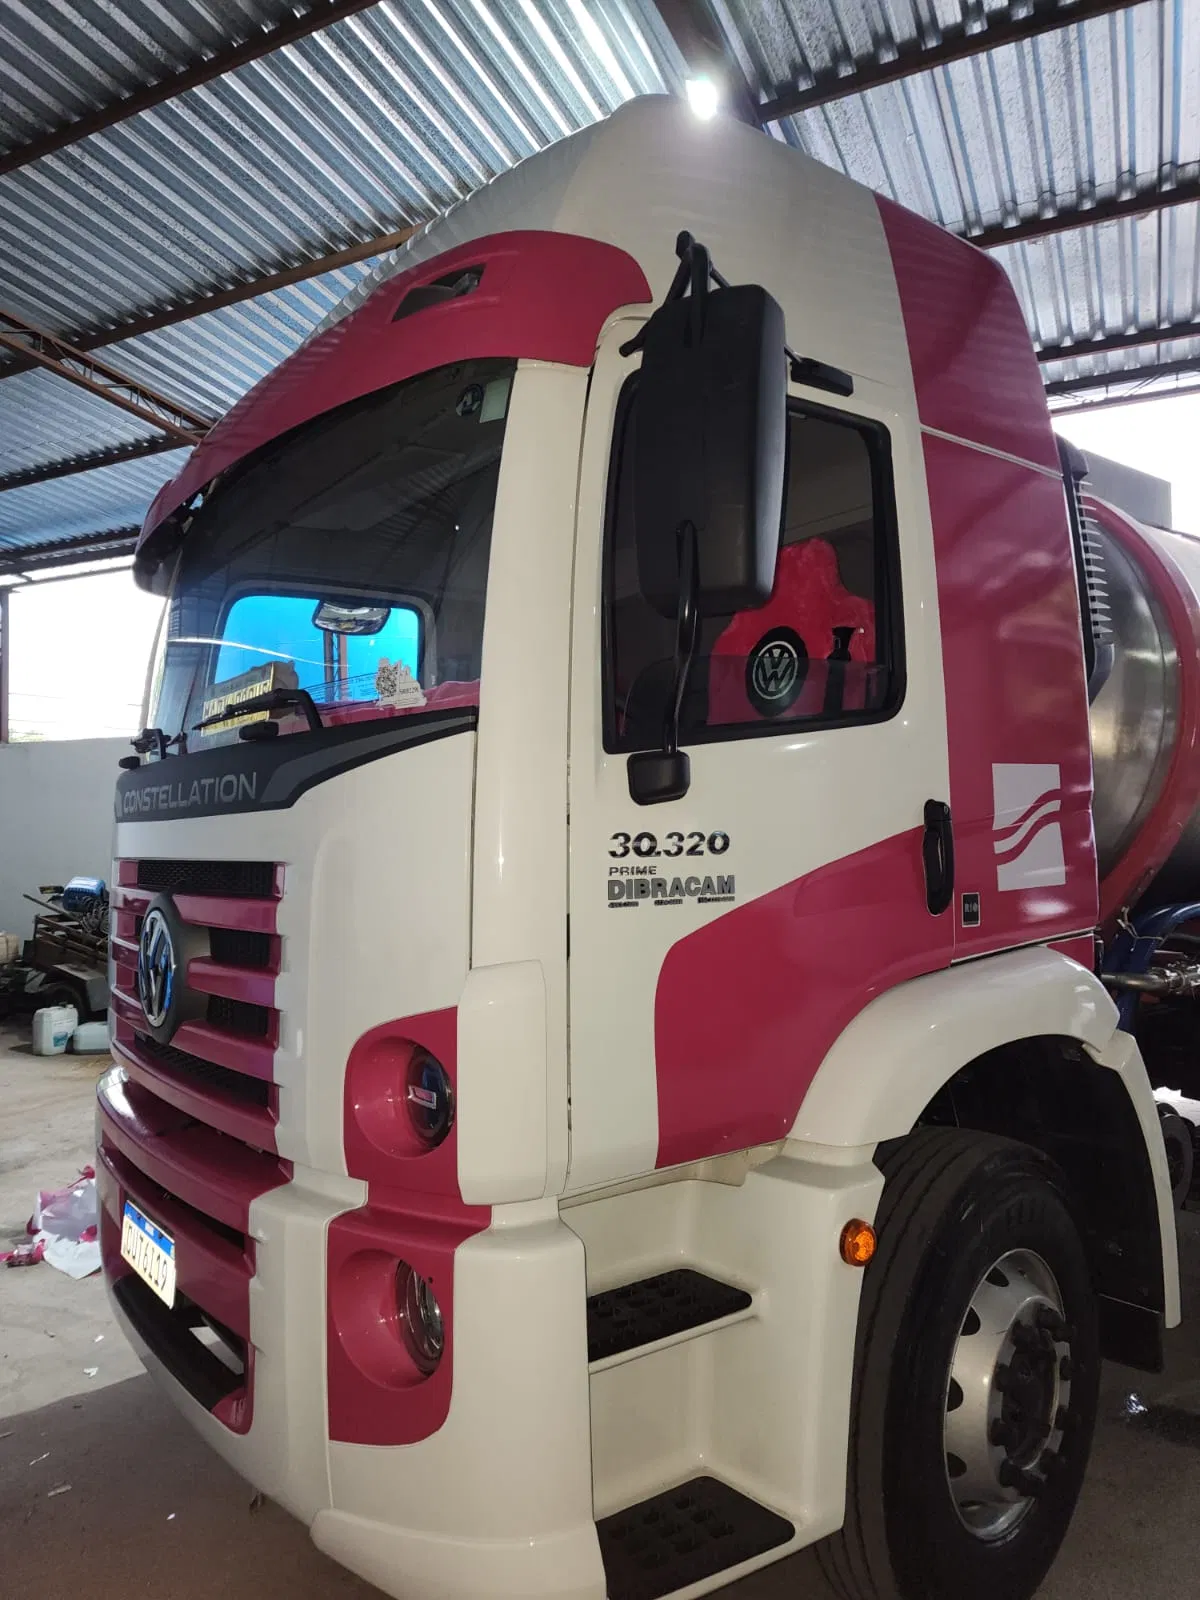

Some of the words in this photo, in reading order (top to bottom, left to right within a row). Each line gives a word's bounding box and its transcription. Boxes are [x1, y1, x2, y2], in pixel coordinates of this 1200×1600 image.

[123, 771, 257, 814] CONSTELLATION
[608, 830, 730, 858] 30.320
[609, 865, 657, 876] PRIME
[607, 875, 735, 900] DIBRACAM
